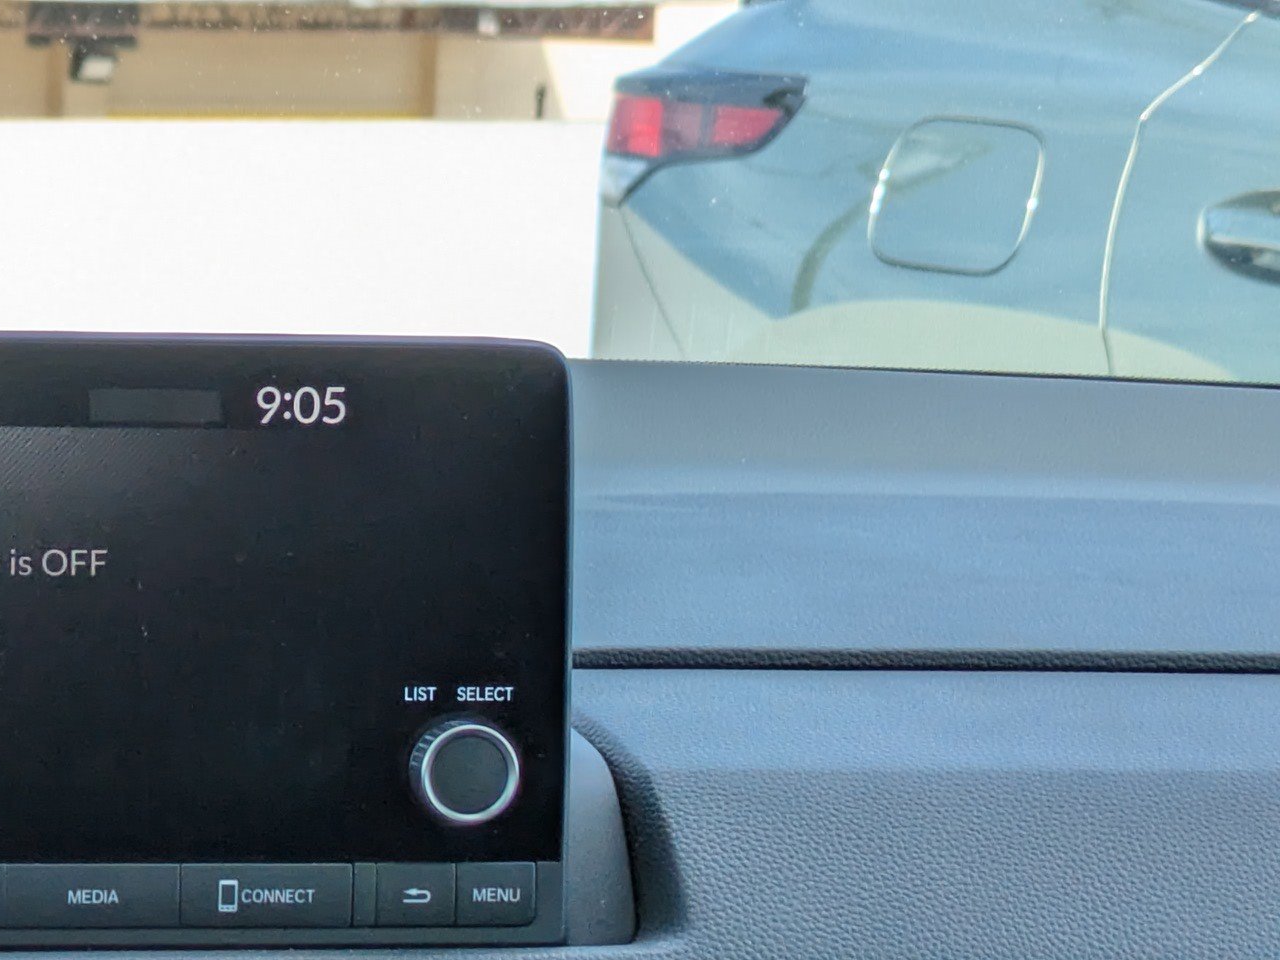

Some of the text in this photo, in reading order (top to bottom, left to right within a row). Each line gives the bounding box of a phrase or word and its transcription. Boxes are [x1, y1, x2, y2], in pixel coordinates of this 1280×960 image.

[256, 385, 347, 425] 9:05
[9, 547, 33, 577] is
[41, 548, 108, 577] OFF
[404, 686, 514, 702] LIST SELECT
[67, 888, 120, 905] MEDIA
[241, 888, 316, 904] CONNECT
[472, 886, 521, 903] MENU
